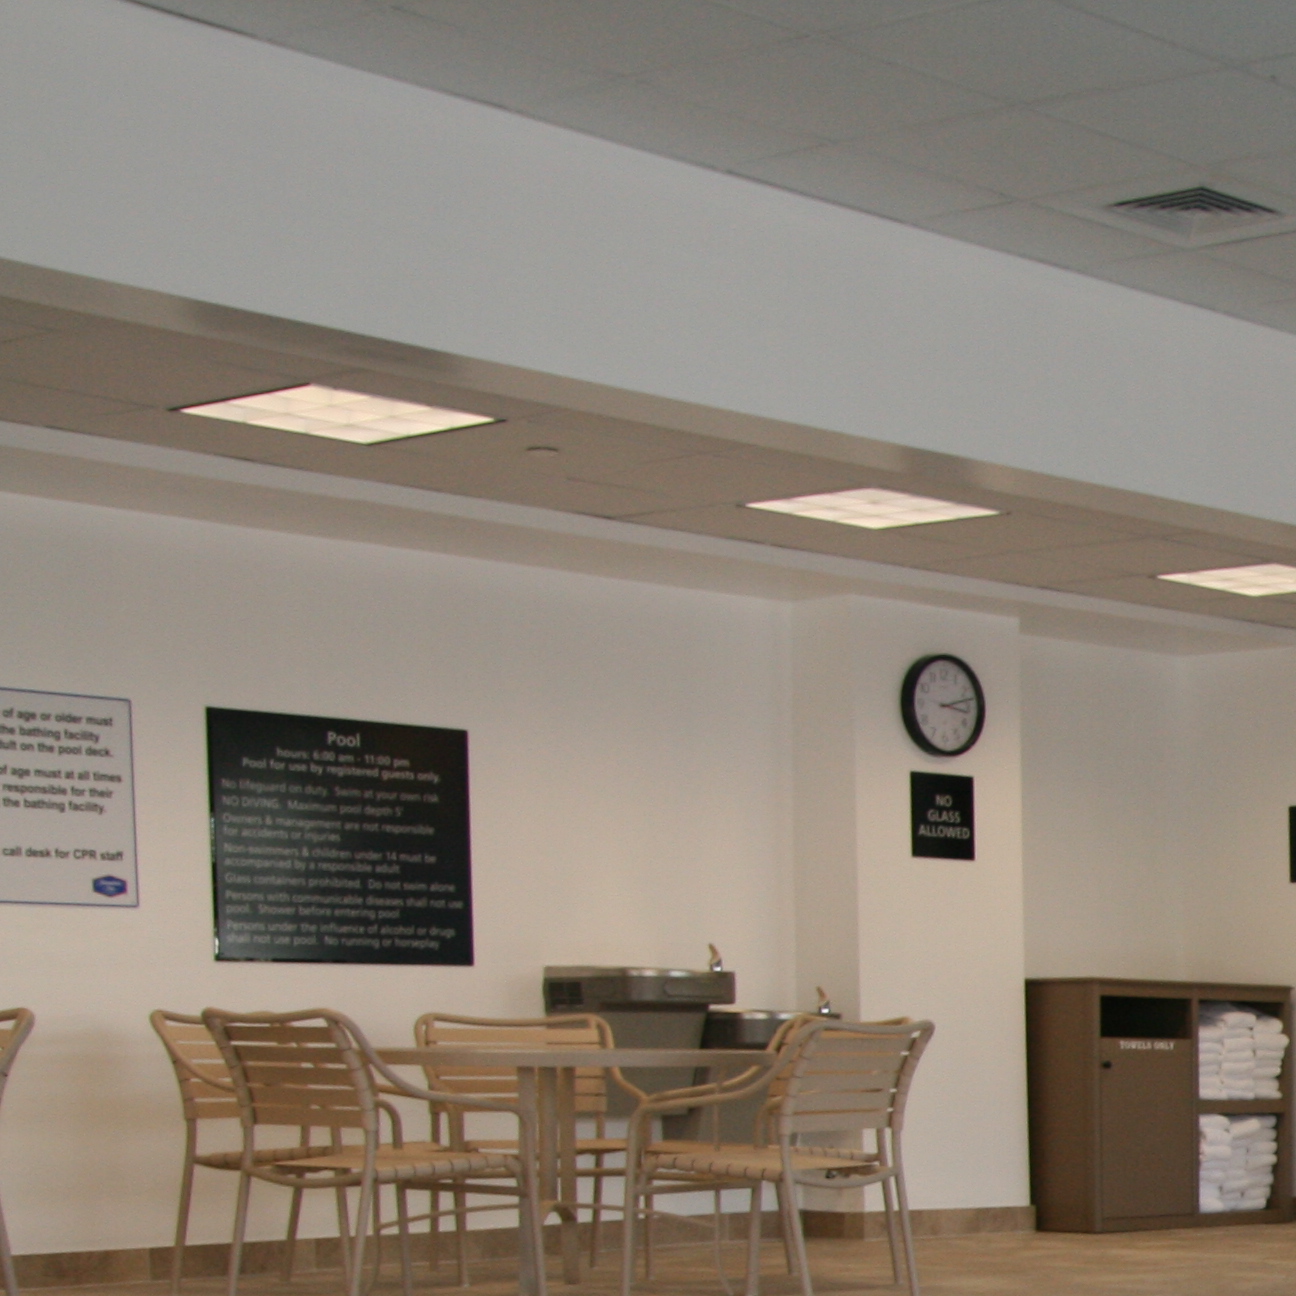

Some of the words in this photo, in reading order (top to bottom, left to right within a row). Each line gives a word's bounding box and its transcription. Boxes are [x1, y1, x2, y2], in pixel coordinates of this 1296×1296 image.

[2, 708, 14, 718] of
[17, 710, 37, 722] age
[40, 713, 51, 721] or
[55, 712, 82, 724] older
[86, 716, 113, 726] must
[19, 726, 61, 741] bathing
[64, 729, 100, 744] facility
[327, 731, 360, 747] Pool
[20, 743, 34, 751] on
[38, 742, 54, 754] the
[58, 744, 81, 756] pool
[242, 757, 267, 768] Pool
[270, 759, 285, 770] for
[310, 762, 323, 776] by
[327, 765, 379, 777] registered
[381, 770, 414, 781] guests
[364, 755, 391, 766] 11:00
[393, 759, 410, 768] pm
[11, 768, 30, 779] age
[34, 770, 62, 779] must
[64, 770, 74, 780] at
[78, 771, 89, 781] all
[93, 772, 122, 783] times
[2, 783, 67, 796] responsible
[71, 786, 85, 797] for
[89, 787, 113, 799] their
[2, 797, 20, 808] the
[23, 798, 65, 813] bathing
[935, 793, 952, 807] NO
[927, 808, 960, 824] GLASS
[918, 824, 970, 840] ALLOWED
[2, 846, 21, 857] call
[25, 846, 51, 858] desk
[55, 848, 69, 858] for
[73, 849, 97, 859] CPR
[100, 851, 123, 861] staff
[386, 851, 397, 860] 14
[1119, 1040, 1152, 1050] TOWELS
[1153, 1040, 1175, 1050] ONLY
